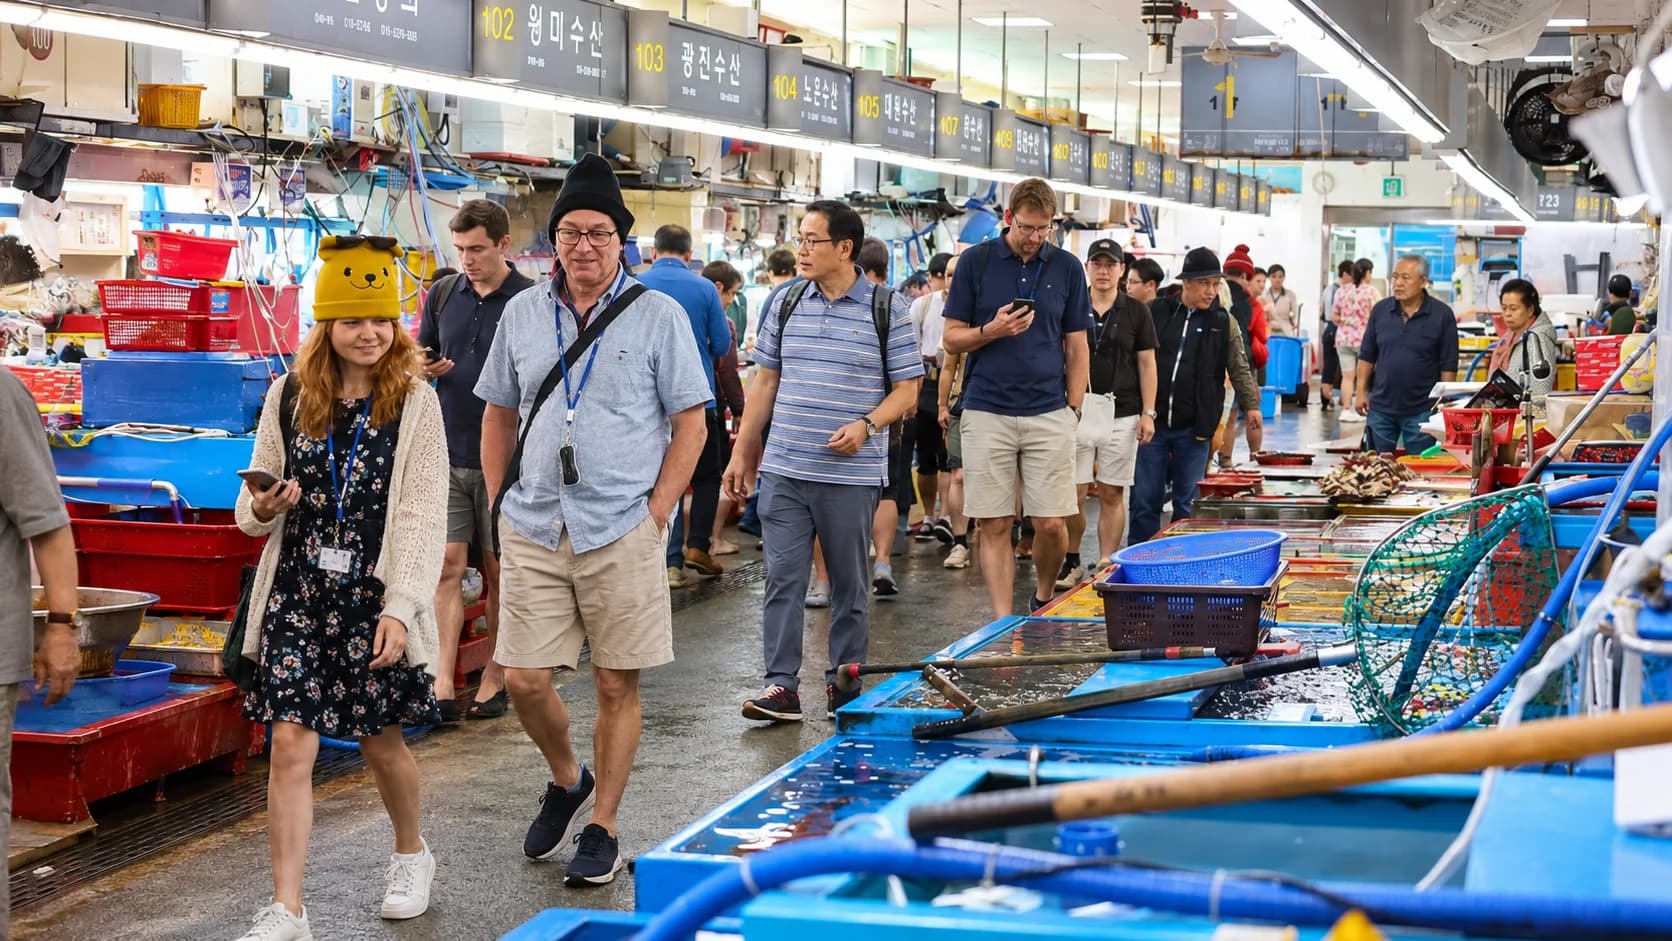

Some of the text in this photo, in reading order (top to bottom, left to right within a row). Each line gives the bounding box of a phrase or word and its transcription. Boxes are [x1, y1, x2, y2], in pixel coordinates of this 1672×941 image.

[482, 5, 515, 41] 102
[636, 41, 740, 87] 103 광진수산
[773, 74, 798, 101] 104
[858, 95, 880, 119] 105
[940, 115, 960, 137] 107
